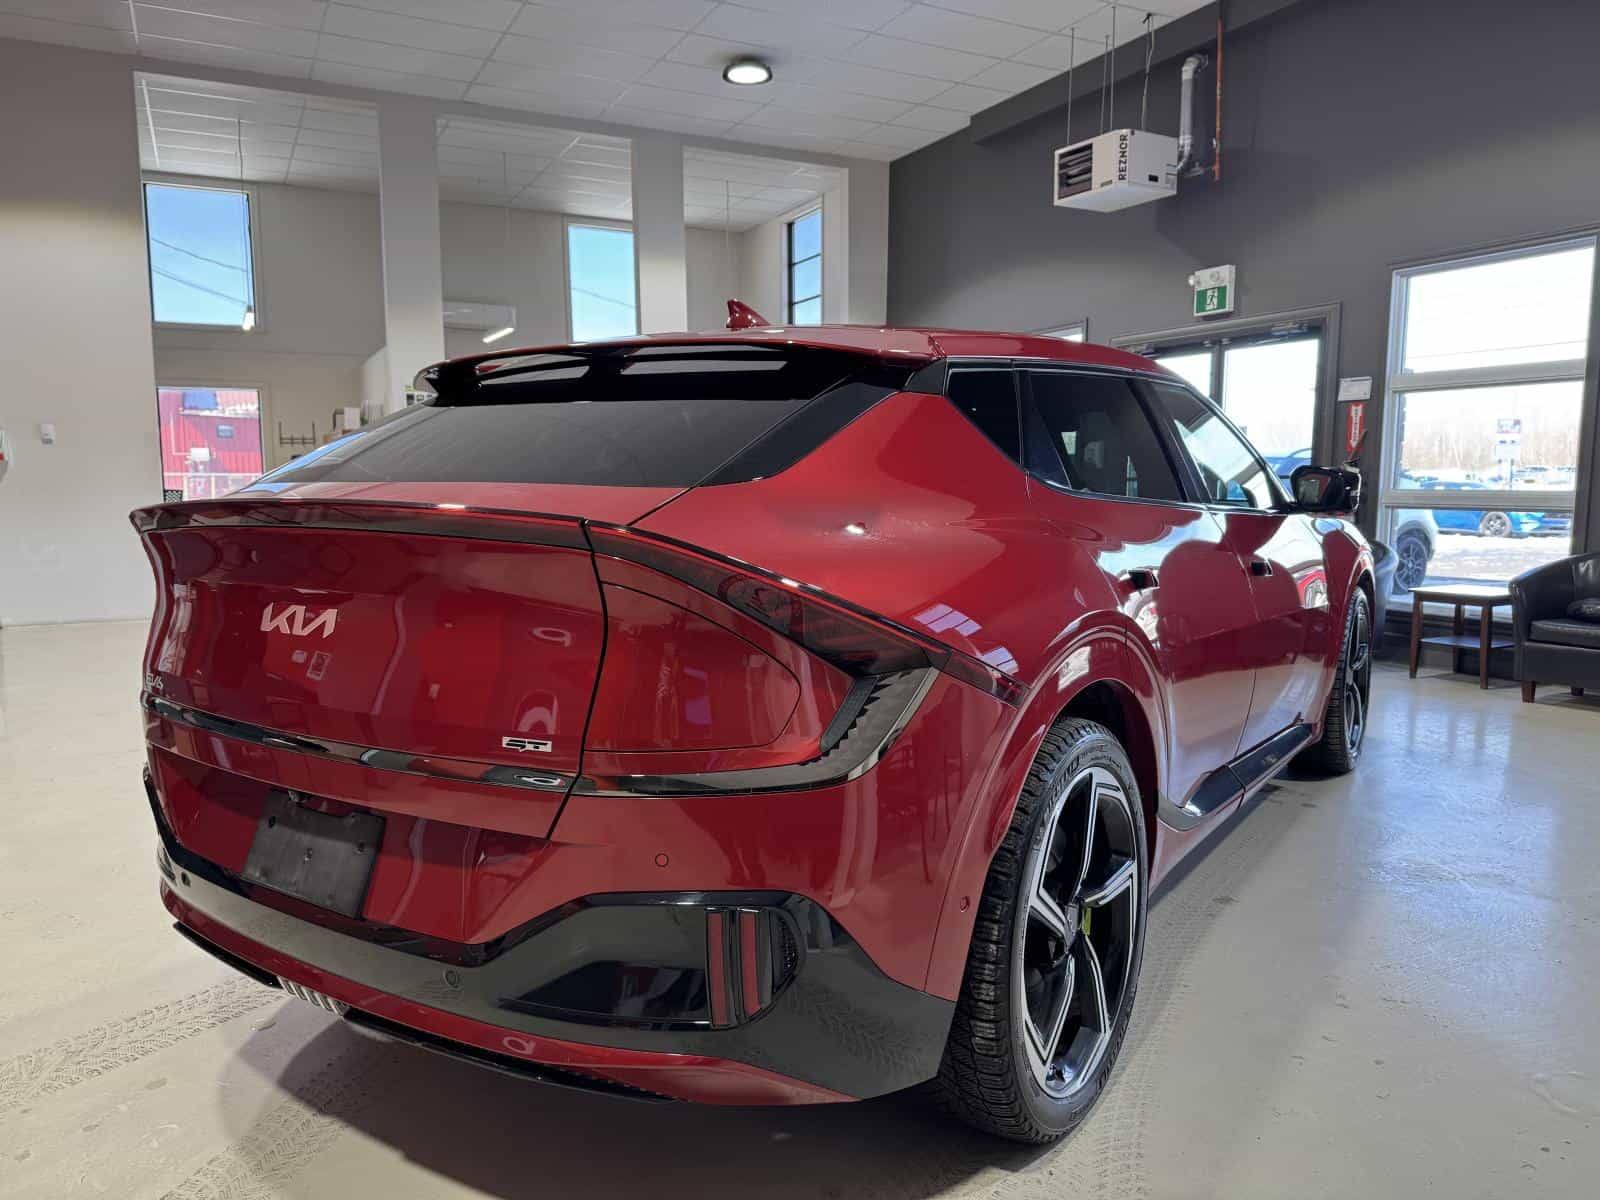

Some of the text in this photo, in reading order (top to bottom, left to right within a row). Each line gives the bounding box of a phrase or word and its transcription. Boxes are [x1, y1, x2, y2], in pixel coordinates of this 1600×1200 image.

[1118, 134, 1129, 181] REZNOR
[260, 602, 338, 638] KIA
[502, 736, 553, 753] GT
